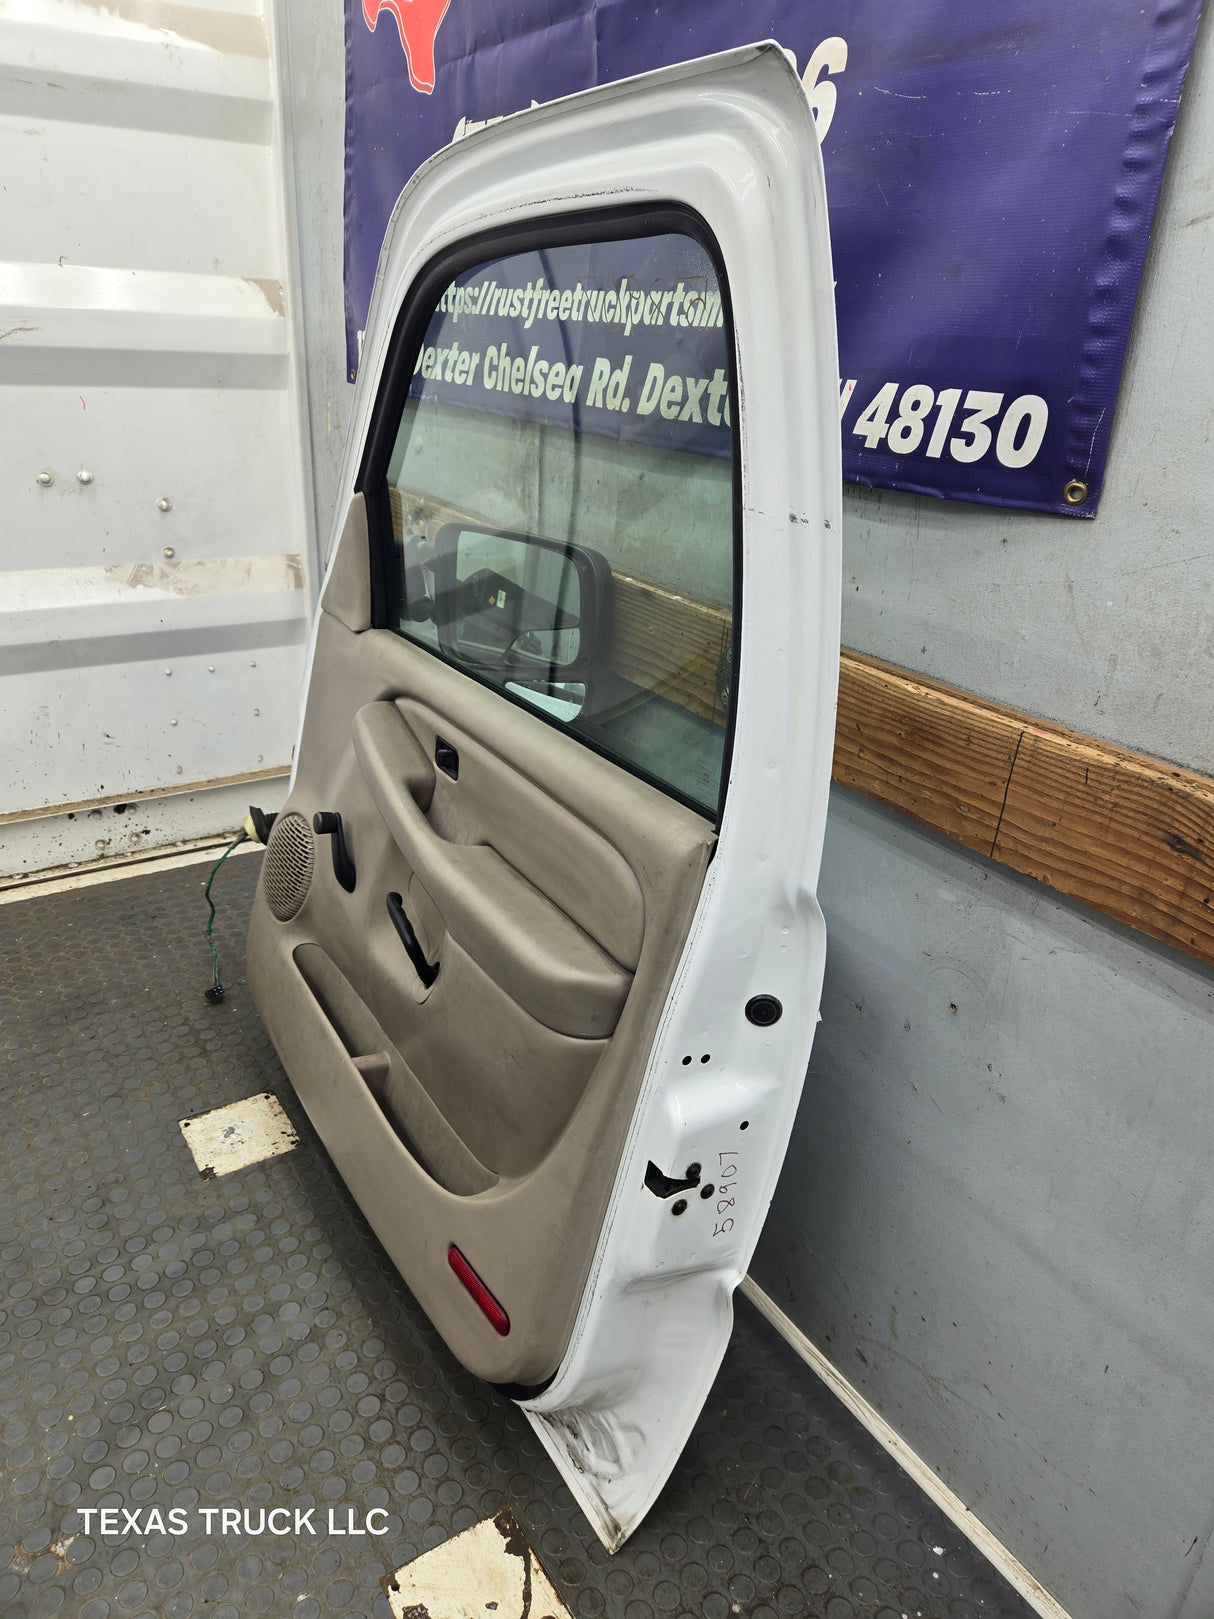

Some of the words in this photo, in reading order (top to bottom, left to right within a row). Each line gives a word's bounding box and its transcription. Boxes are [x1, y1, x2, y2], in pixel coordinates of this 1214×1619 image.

[483, 343, 583, 404] Chelsea
[585, 354, 633, 413] Rd.
[852, 381, 1049, 469] 48130
[712, 1151, 738, 1237] 58907
